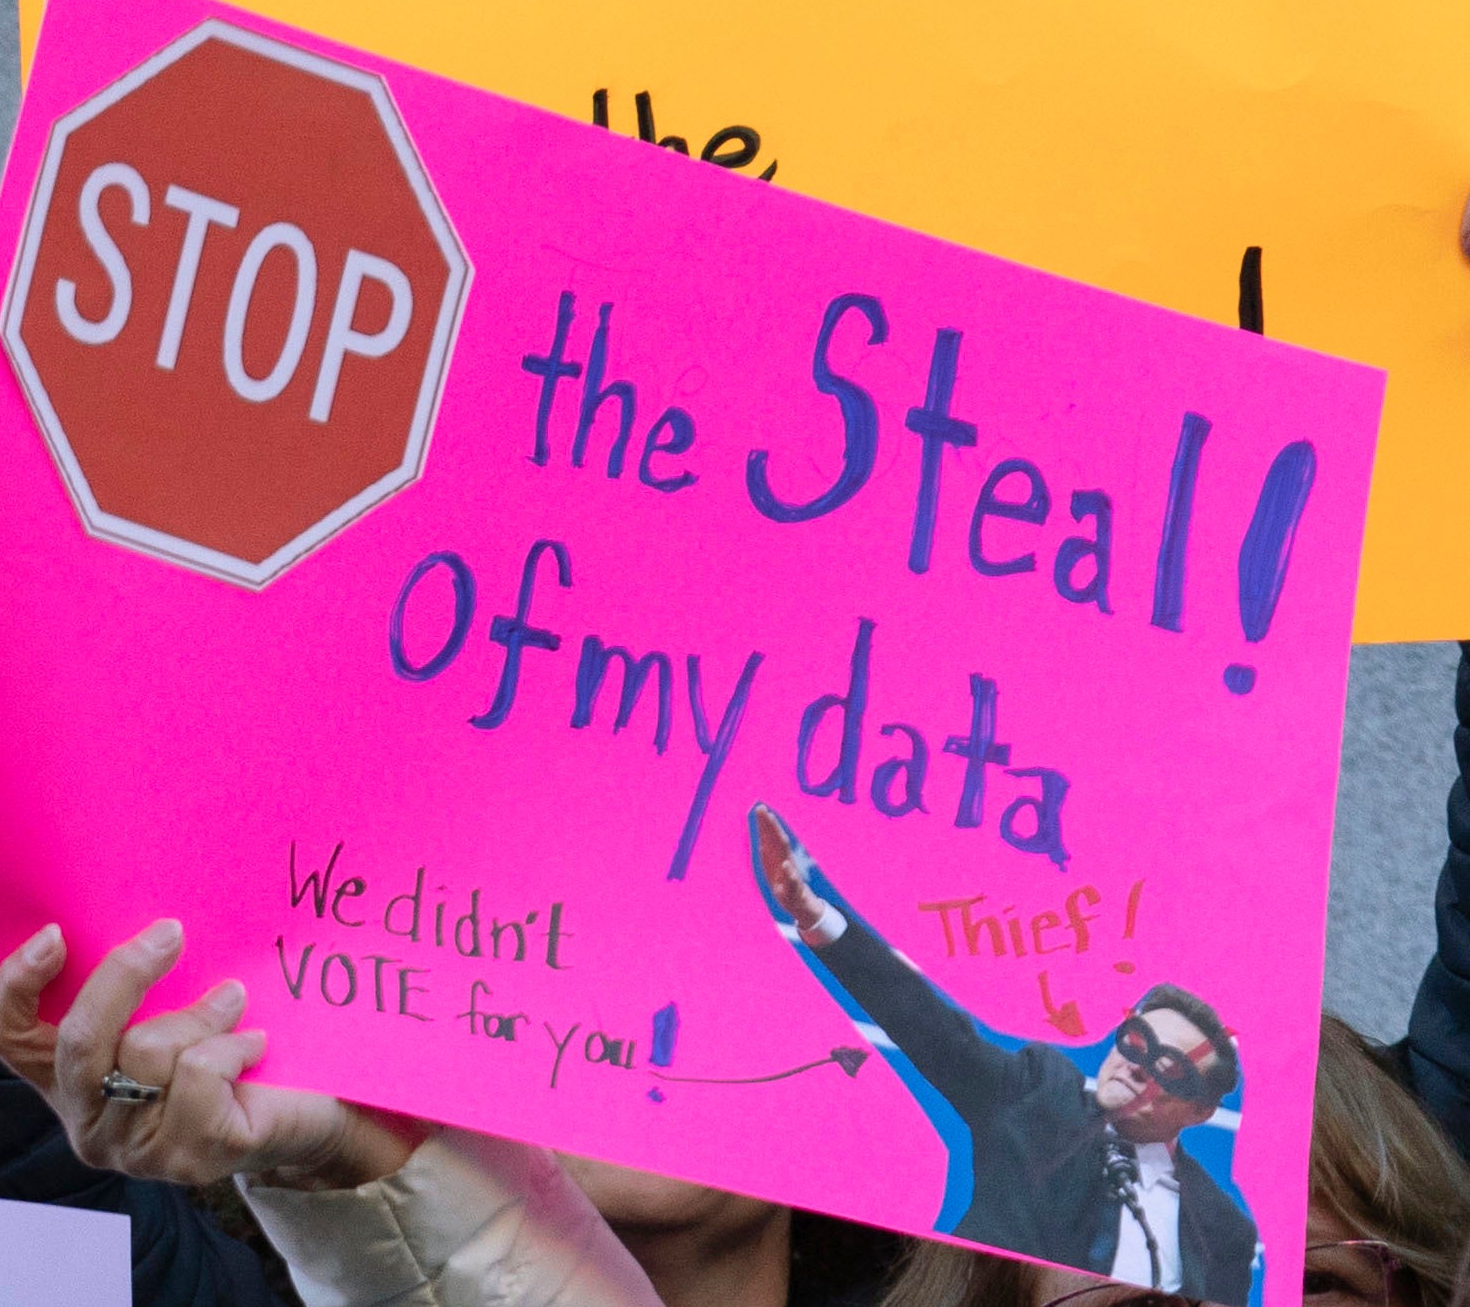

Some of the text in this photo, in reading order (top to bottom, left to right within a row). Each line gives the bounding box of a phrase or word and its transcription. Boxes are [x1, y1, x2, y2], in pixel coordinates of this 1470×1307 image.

[53, 161, 413, 424] STOP
[520, 291, 1318, 695] the Steal!
[571, 634, 765, 882] my
[797, 617, 1072, 873] data
[275, 935, 434, 1021] VOTE
[457, 980, 529, 1042] for
[290, 841, 575, 970] We didn't
[917, 879, 1145, 974] Thief!
